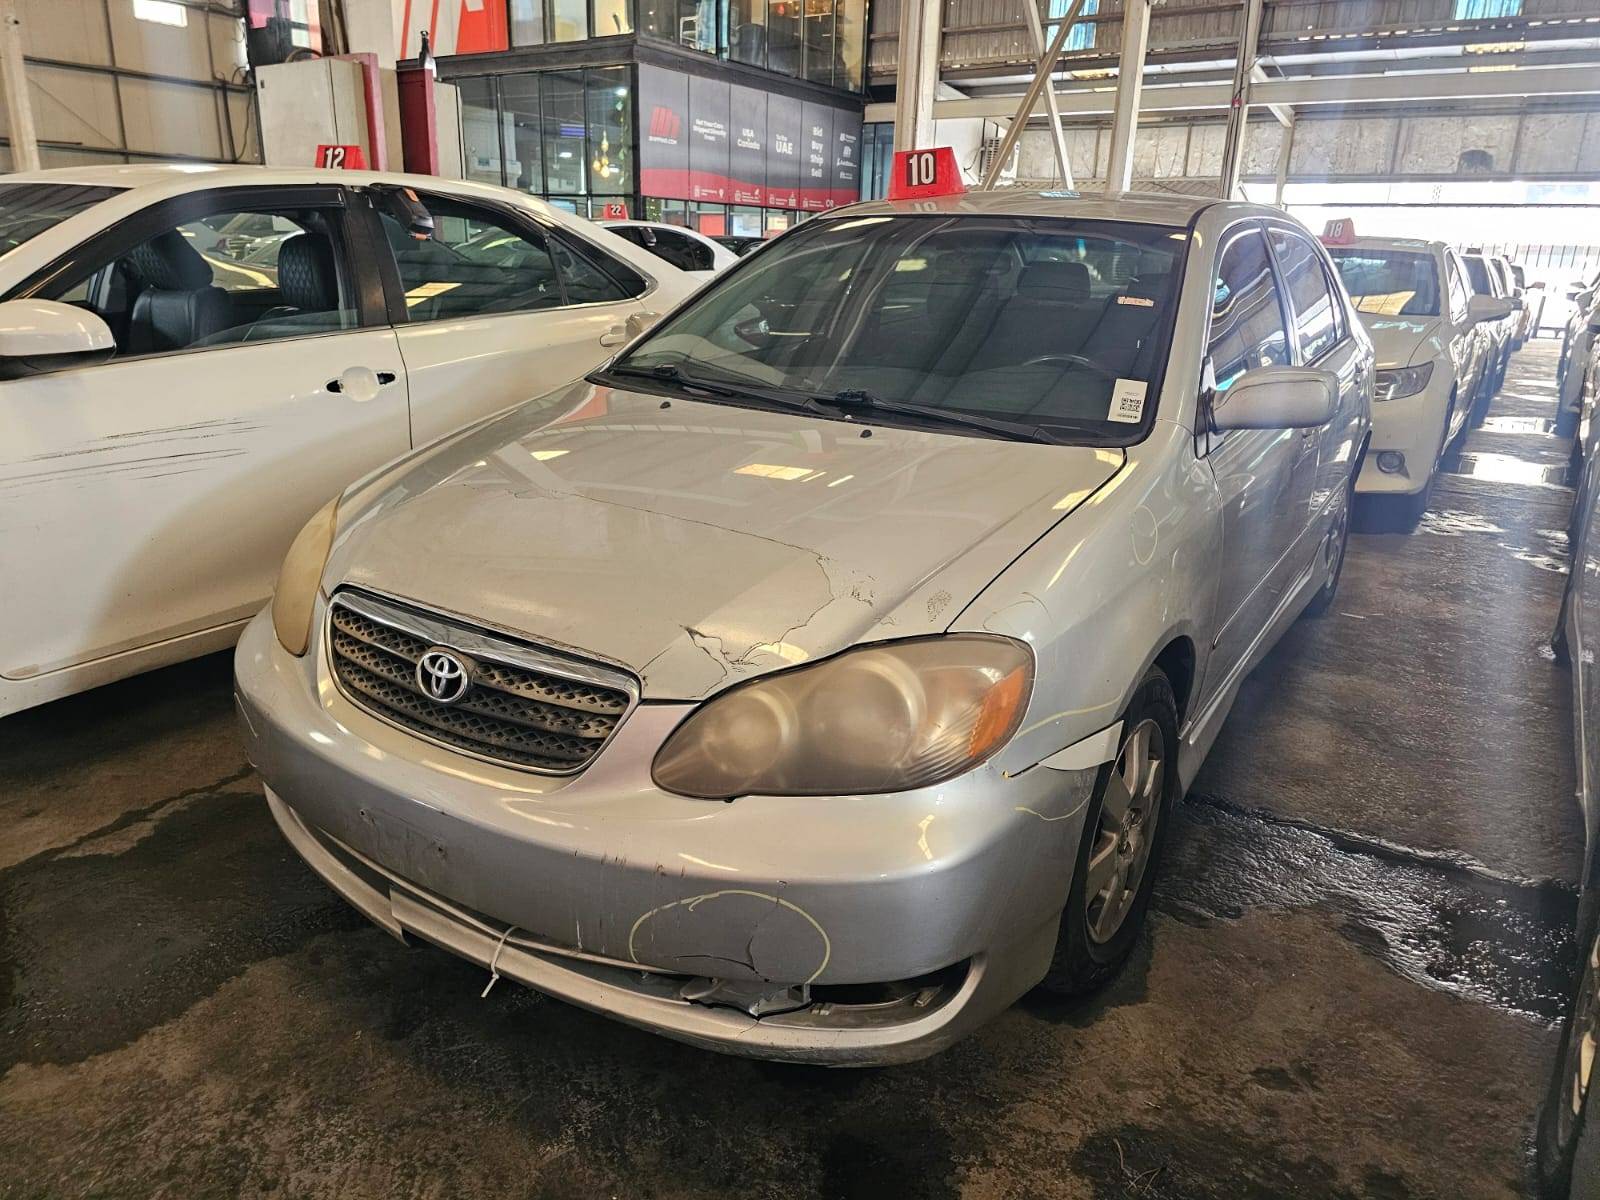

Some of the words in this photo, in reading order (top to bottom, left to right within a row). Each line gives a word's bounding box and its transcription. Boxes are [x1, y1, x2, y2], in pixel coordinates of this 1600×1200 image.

[742, 127, 755, 138] USA
[812, 126, 823, 137] Bid
[737, 139, 760, 150] Canada
[775, 141, 793, 155] UAE
[811, 141, 824, 153] Buy
[326, 147, 345, 169] 12
[810, 154, 824, 167] Ship
[811, 168, 822, 178] Sell
[909, 152, 935, 186] 10
[610, 205, 622, 216] 22
[1329, 222, 1344, 238] 18
